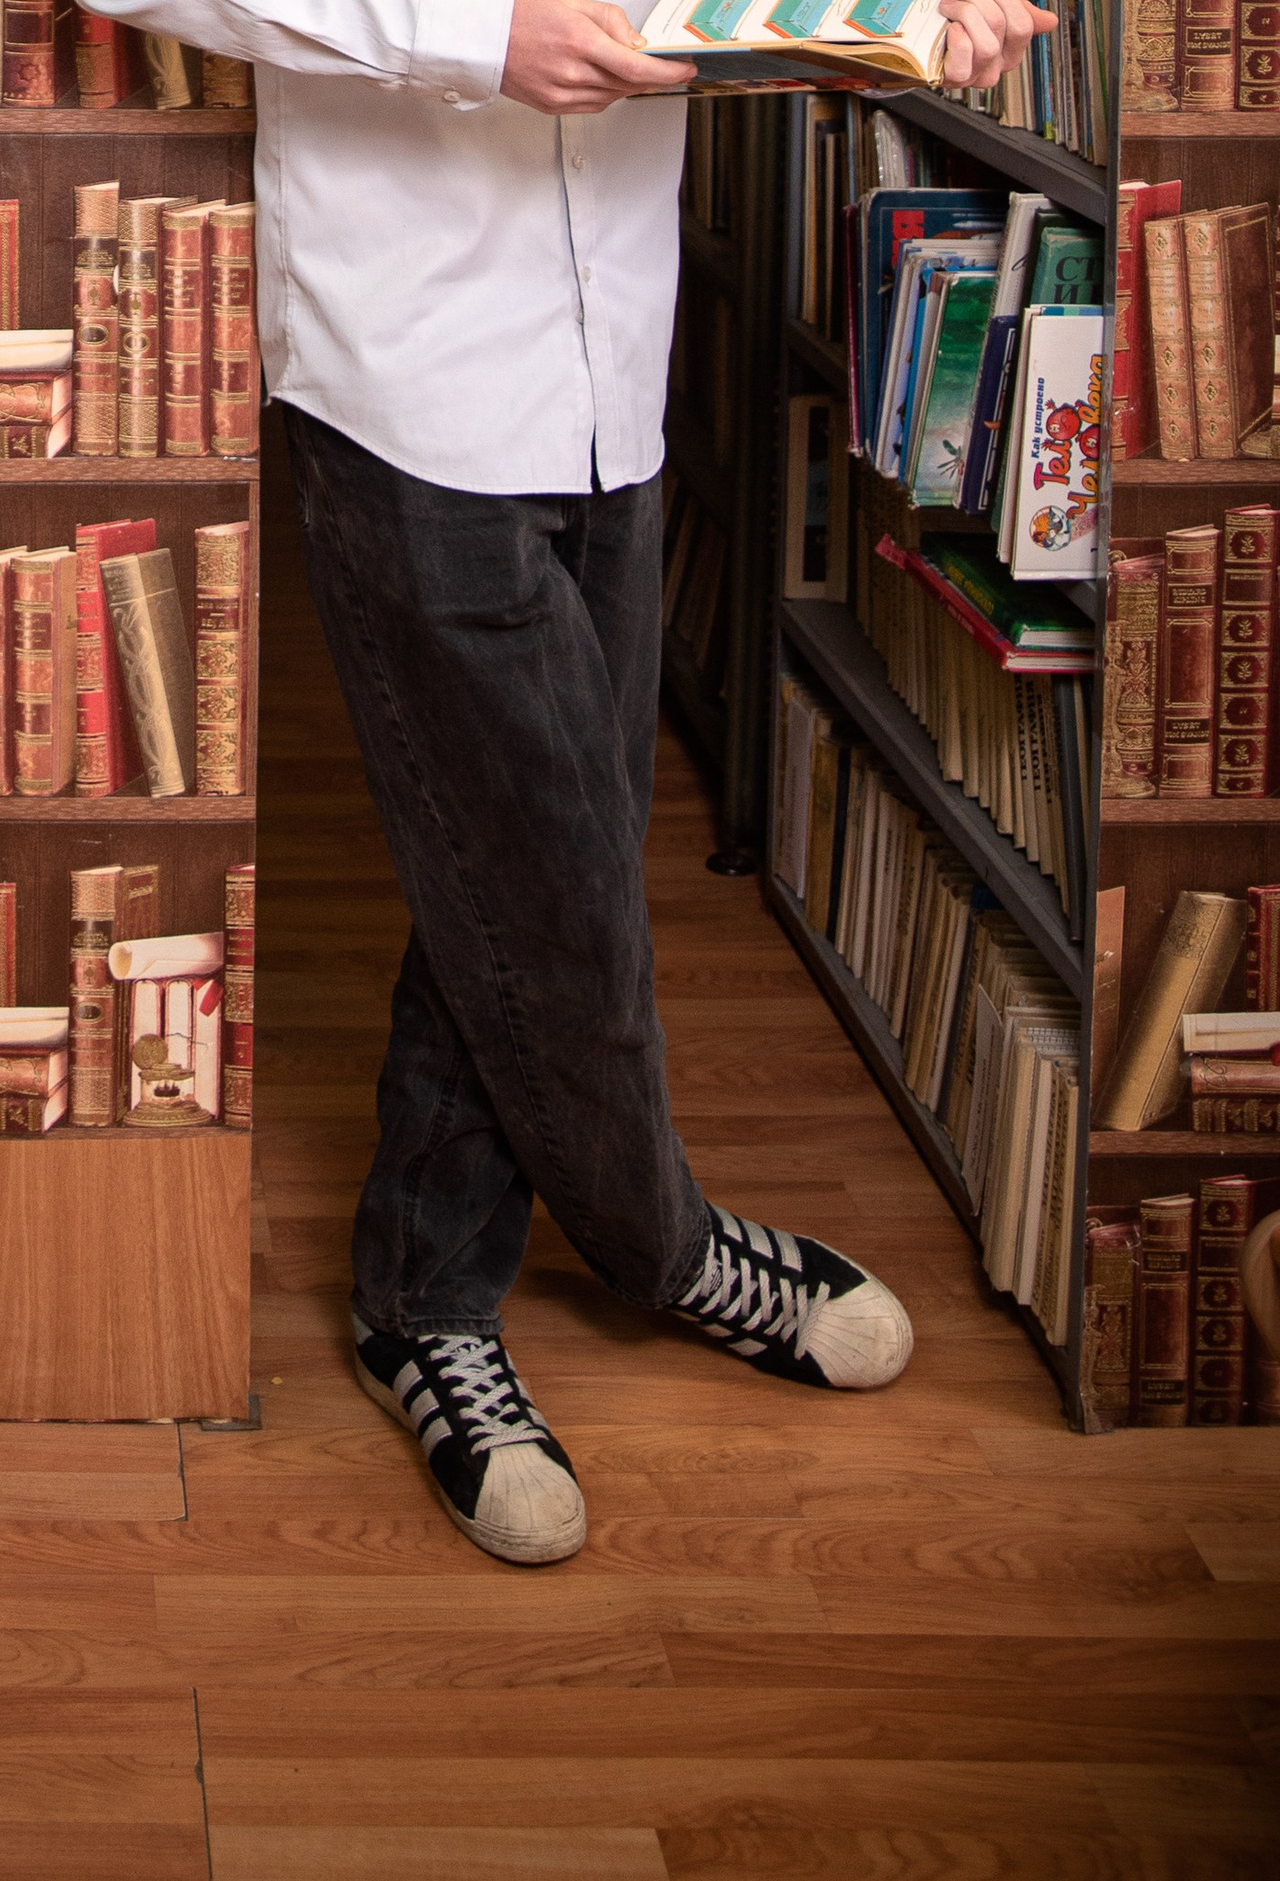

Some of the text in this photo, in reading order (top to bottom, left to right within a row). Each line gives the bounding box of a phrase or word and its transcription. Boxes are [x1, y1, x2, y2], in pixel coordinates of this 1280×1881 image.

[1031, 377, 1045, 459] Как устроено
[1026, 680, 1041, 791] ГЕОГРАФИЯ
